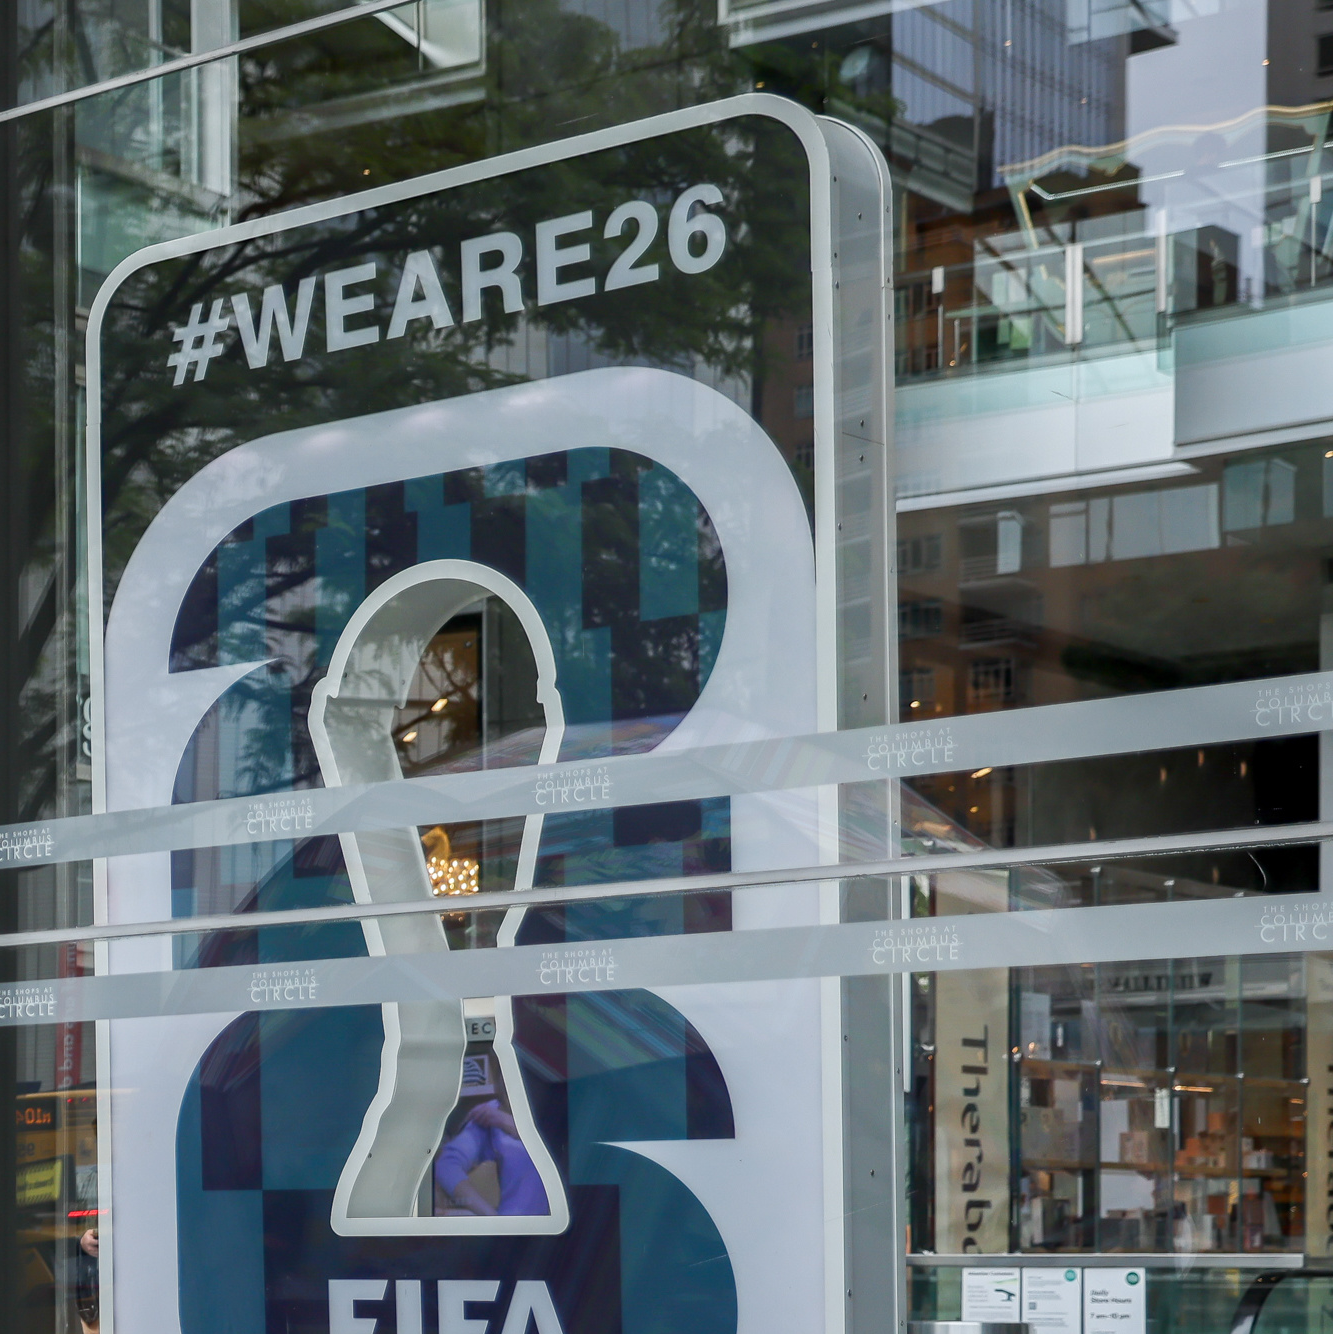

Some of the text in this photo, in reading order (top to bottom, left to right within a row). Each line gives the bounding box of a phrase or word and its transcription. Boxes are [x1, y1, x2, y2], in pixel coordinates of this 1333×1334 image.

[167, 183, 728, 388] #WEARE26
[1289, 681, 1331, 693] SHOPS
[1255, 691, 1332, 710] COLUMB
[1255, 701, 1333, 726] CIRC
[895, 730, 931, 740] SHOPS
[938, 727, 951, 735] AT
[867, 736, 953, 755] COLUMBUS
[867, 746, 953, 770] CIRCLE
[560, 768, 591, 778] SHOPS
[535, 774, 610, 791] COLUMBUS
[535, 784, 610, 805] CIRCLE
[268, 800, 296, 808] SHOPS
[247, 805, 312, 821] COLUMBUS
[247, 815, 312, 834] CIRCLE
[13, 829, 37, 837] SHOPS
[900, 926, 936, 936] SHOPS
[1260, 922, 1327, 942] CIRC
[872, 934, 958, 949] COLUMBUS
[564, 950, 596, 958] SHOPS
[872, 944, 958, 964] CIRCLE
[540, 956, 614, 971] COLUMBUS
[272, 970, 300, 978] SHOPS
[540, 965, 614, 985] CIRCLE
[250, 976, 316, 989] COLUMBUS
[250, 985, 316, 1003] CIRCLE
